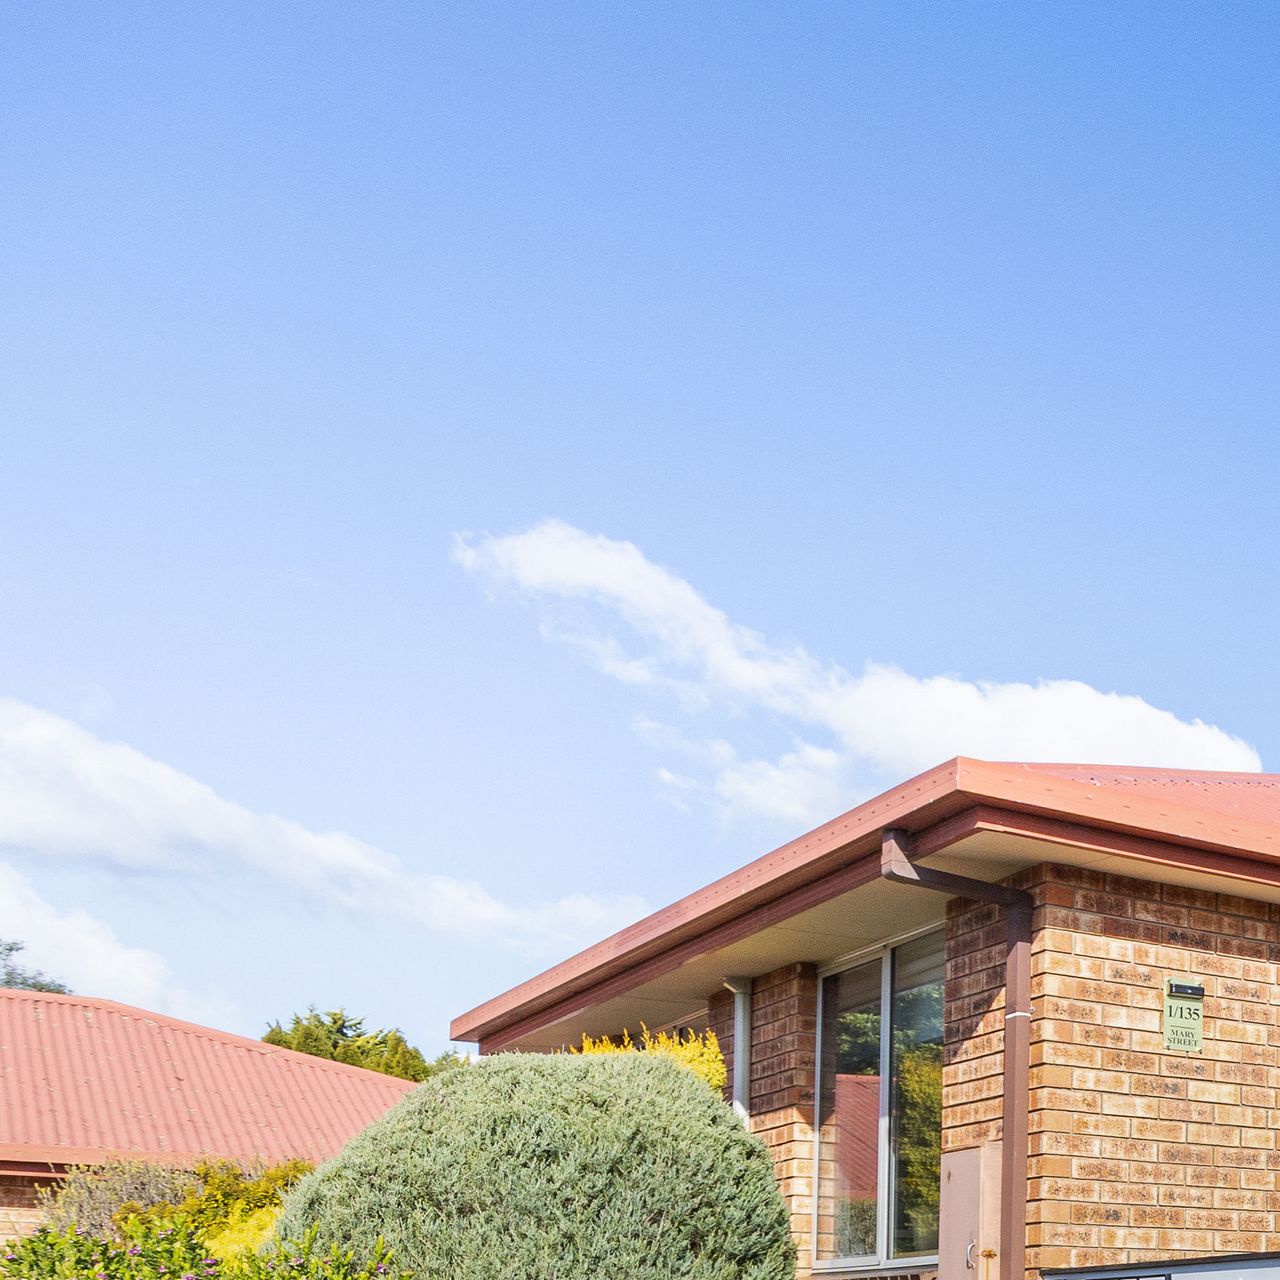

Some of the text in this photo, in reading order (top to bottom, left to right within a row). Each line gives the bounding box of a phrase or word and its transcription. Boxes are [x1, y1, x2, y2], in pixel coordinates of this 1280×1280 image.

[1168, 1005, 1200, 1020] 1/135
[1170, 1030, 1196, 1039] MARY
[1167, 1037, 1198, 1047] STREET
